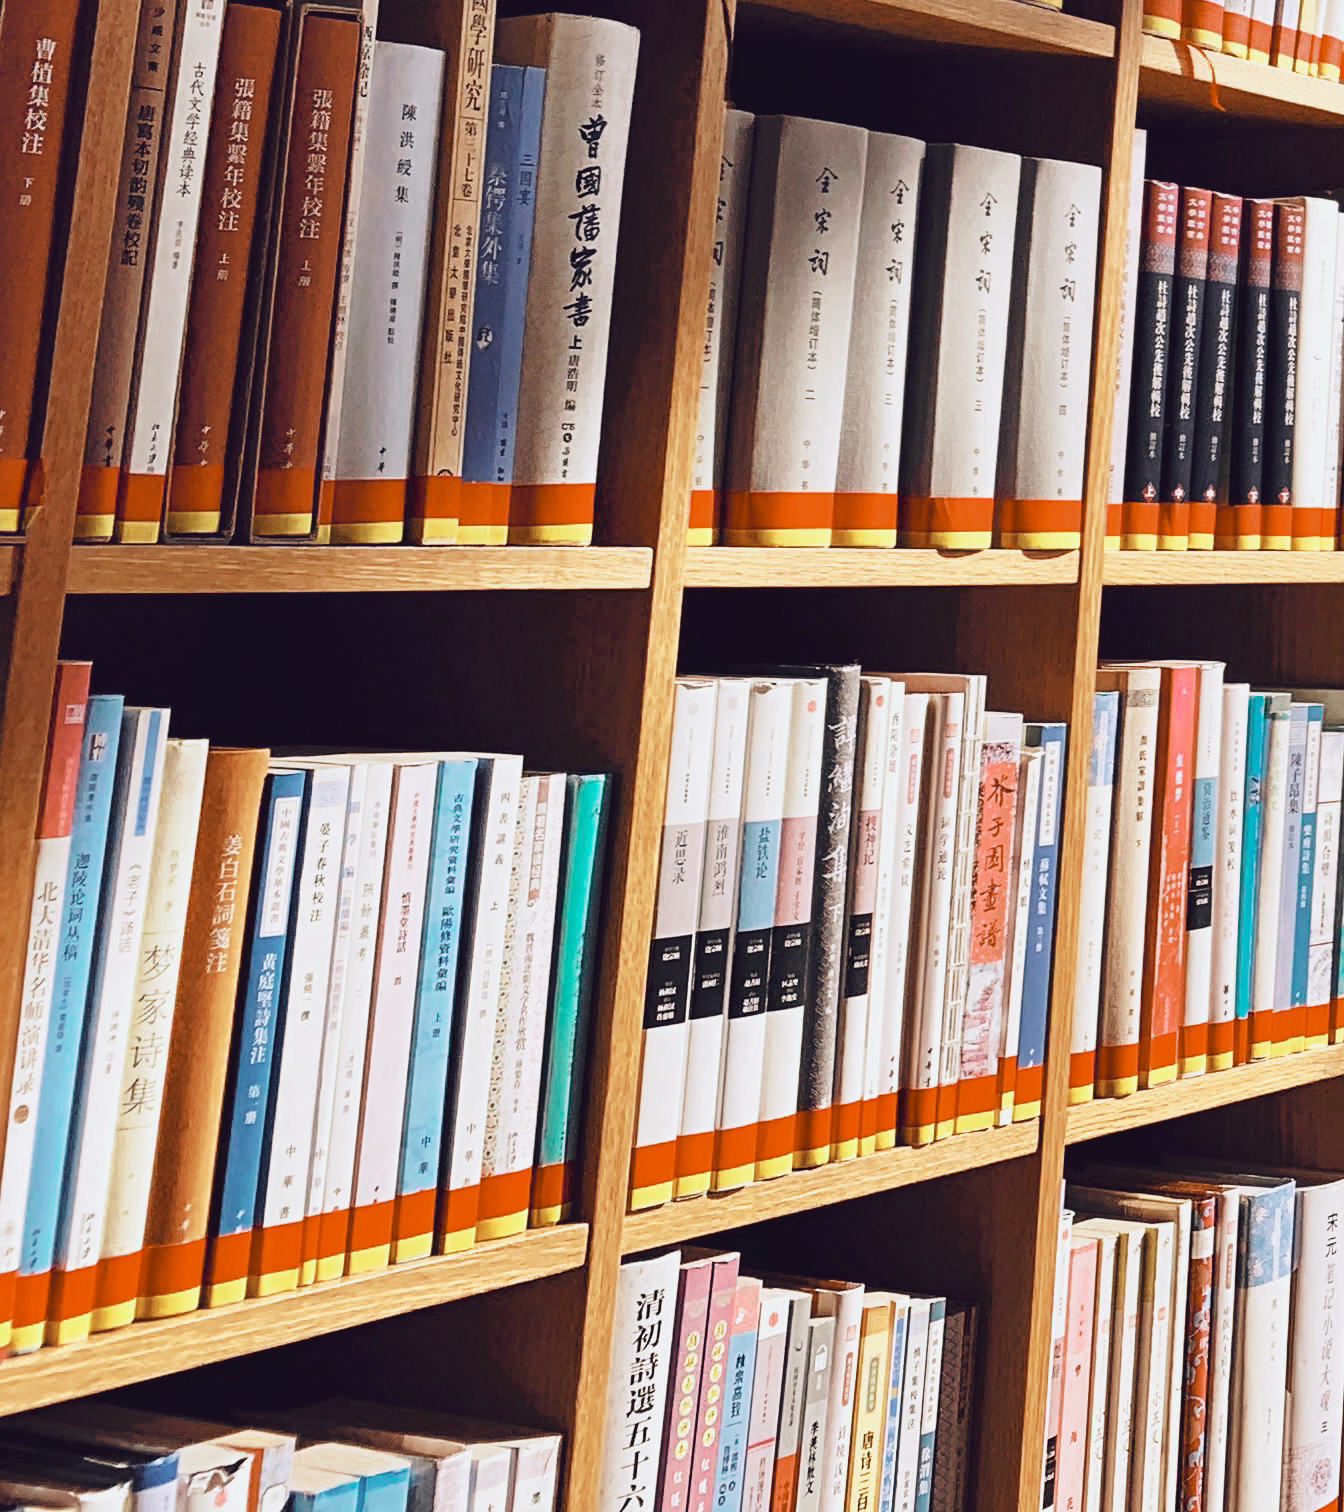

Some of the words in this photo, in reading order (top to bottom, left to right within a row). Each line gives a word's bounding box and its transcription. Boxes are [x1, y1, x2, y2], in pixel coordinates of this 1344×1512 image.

[22, 38, 57, 156] 曹植集校注
[177, 62, 207, 198] 古代文学经典读本
[394, 104, 418, 203] 陳洪綬集
[516, 154, 536, 206] 三国宴
[563, 114, 608, 328] 曾國藩家書
[808, 167, 839, 276] 全宋词
[885, 179, 910, 285] 全宋词
[975, 192, 998, 294] 全宋词
[1059, 204, 1082, 302] 全宋词
[566, 354, 580, 392] 唐浩明
[568, 335, 583, 350] 上
[805, 389, 816, 401] 二
[884, 393, 893, 406] 三
[974, 400, 982, 412] 三
[1058, 404, 1067, 416] 四
[1288, 753, 1302, 814] 陳子昂集
[269, 808, 292, 924] 中國古典文學基本叢書
[494, 792, 511, 865] 四書講義
[672, 829, 688, 885] 近思录
[712, 825, 730, 897] 淮南鸿烈
[755, 826, 771, 879] 盐铁论
[864, 815, 877, 866] 搜神记
[62, 853, 91, 961] 迦陵论词丛稿
[205, 834, 243, 974] 姜白石詞箋注
[309, 822, 331, 923] 晏子春秋校注
[16, 882, 57, 1095] 北大清华名师演讲录
[434, 905, 455, 992] 歐陽修資料彙編
[120, 944, 175, 1116] 梦家诗集
[279, 1144, 297, 1219] 中華書
[418, 1136, 431, 1173] 中華
[1319, 1212, 1339, 1412] 宋元笔记小说大观
[616, 1288, 665, 1511] 清初詩選五十六
[731, 1354, 746, 1418] 林泉高致
